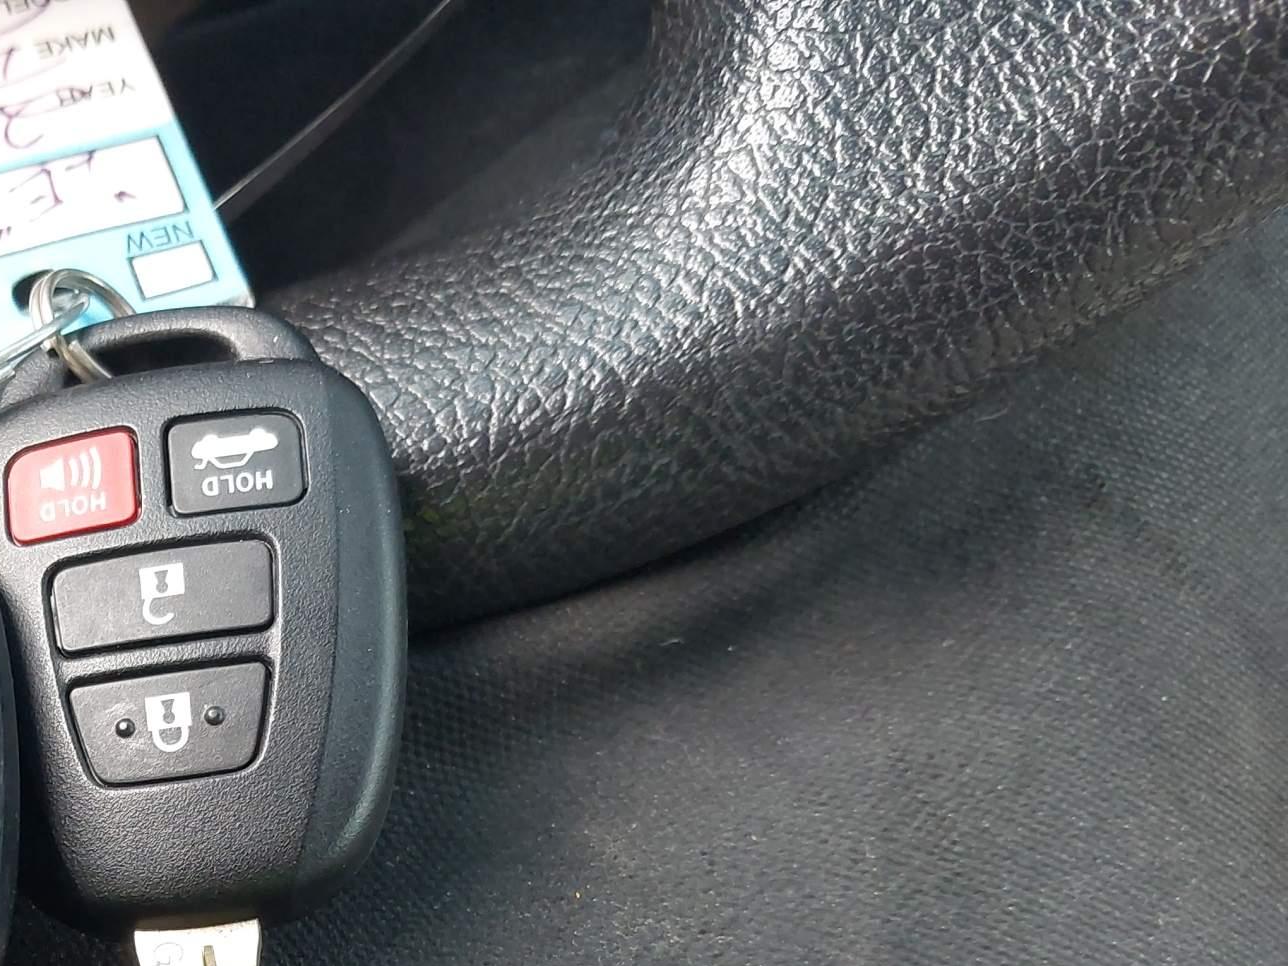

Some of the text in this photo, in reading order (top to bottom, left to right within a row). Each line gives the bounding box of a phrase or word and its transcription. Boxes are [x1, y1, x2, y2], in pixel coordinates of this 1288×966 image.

[34, 26, 116, 60] MAKE
[55, 78, 136, 107] YEAR
[126, 220, 194, 257] NEW
[201, 469, 274, 497] HOLD
[39, 491, 107, 522] HOLD
